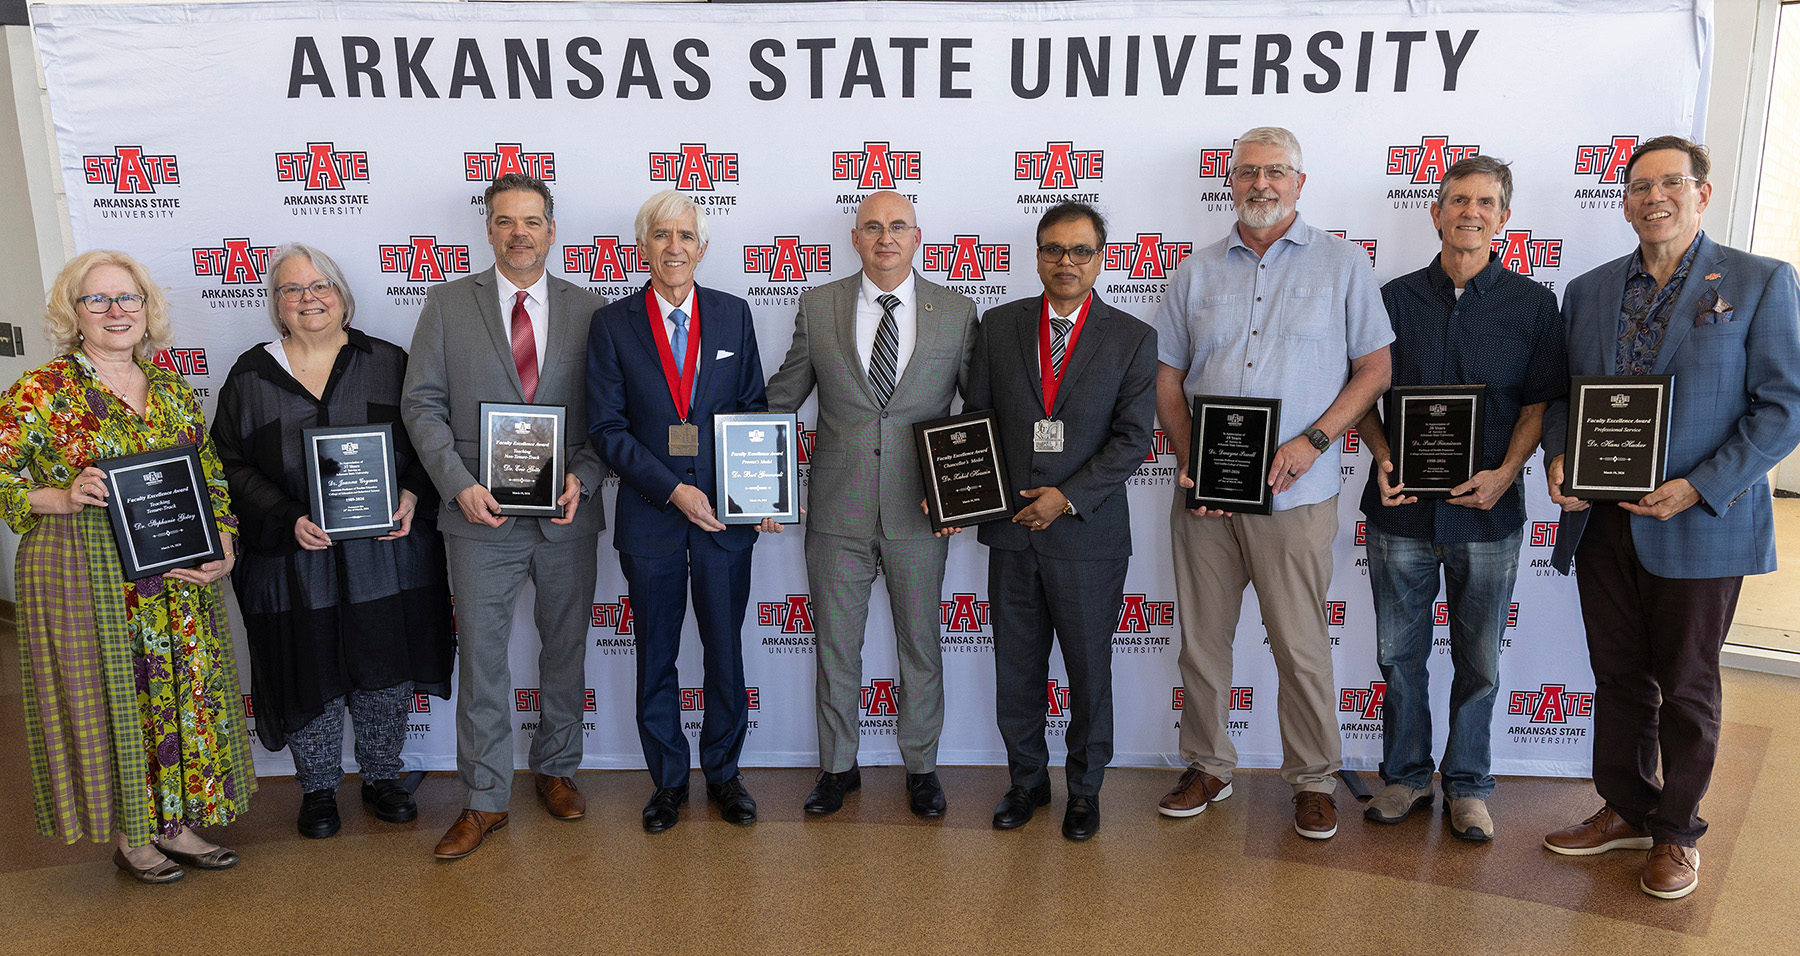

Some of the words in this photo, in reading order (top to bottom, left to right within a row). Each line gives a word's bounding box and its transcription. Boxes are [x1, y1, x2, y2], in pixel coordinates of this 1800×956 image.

[287, 36, 712, 100] ARKANSAS
[748, 37, 975, 100] STATE
[1010, 29, 1480, 100] UNIVERSITY
[1574, 135, 1639, 184] STA
[82, 145, 180, 194] STATE
[275, 141, 370, 190] STATE
[649, 143, 739, 191] STATE
[833, 141, 921, 189] STATE
[1015, 141, 1104, 189] STATE
[1201, 192, 1233, 201] ARKAN
[1574, 189, 1623, 199] ARKANSA
[93, 199, 148, 208] ARKANSAS
[150, 198, 180, 208] STATE
[284, 196, 338, 206] ARKANSAS
[339, 195, 369, 205] STATE
[708, 196, 736, 205] STATE
[102, 210, 175, 219] UNIVERSITY
[292, 207, 363, 215] UNIVERSITY
[379, 236, 471, 282] STATE
[744, 236, 831, 282] STATE
[923, 235, 1010, 281] STATE
[202, 289, 255, 298] ARKANSAS
[387, 287, 428, 295] ARKANS
[748, 287, 799, 296] ARKANSAS
[979, 286, 1007, 295] STATE
[1106, 284, 1158, 293] ARKANSAS
[210, 300, 266, 308] UNIVERSI
[1113, 296, 1161, 304] UNIVERS
[127, 495, 146, 504] Faculty
[172, 486, 189, 494] Award
[133, 522, 146, 530] Dr.
[758, 594, 815, 634] STA
[1115, 594, 1174, 633] ATE
[1112, 637, 1142, 645] ANSAS
[1144, 637, 1170, 645] STATE
[1339, 681, 1386, 720] STA
[1507, 684, 1594, 724] STATE
[1508, 727, 1558, 736] ARKANSAS
[1559, 727, 1586, 736] STATE
[1513, 737, 1578, 745] UNIVERSITY
